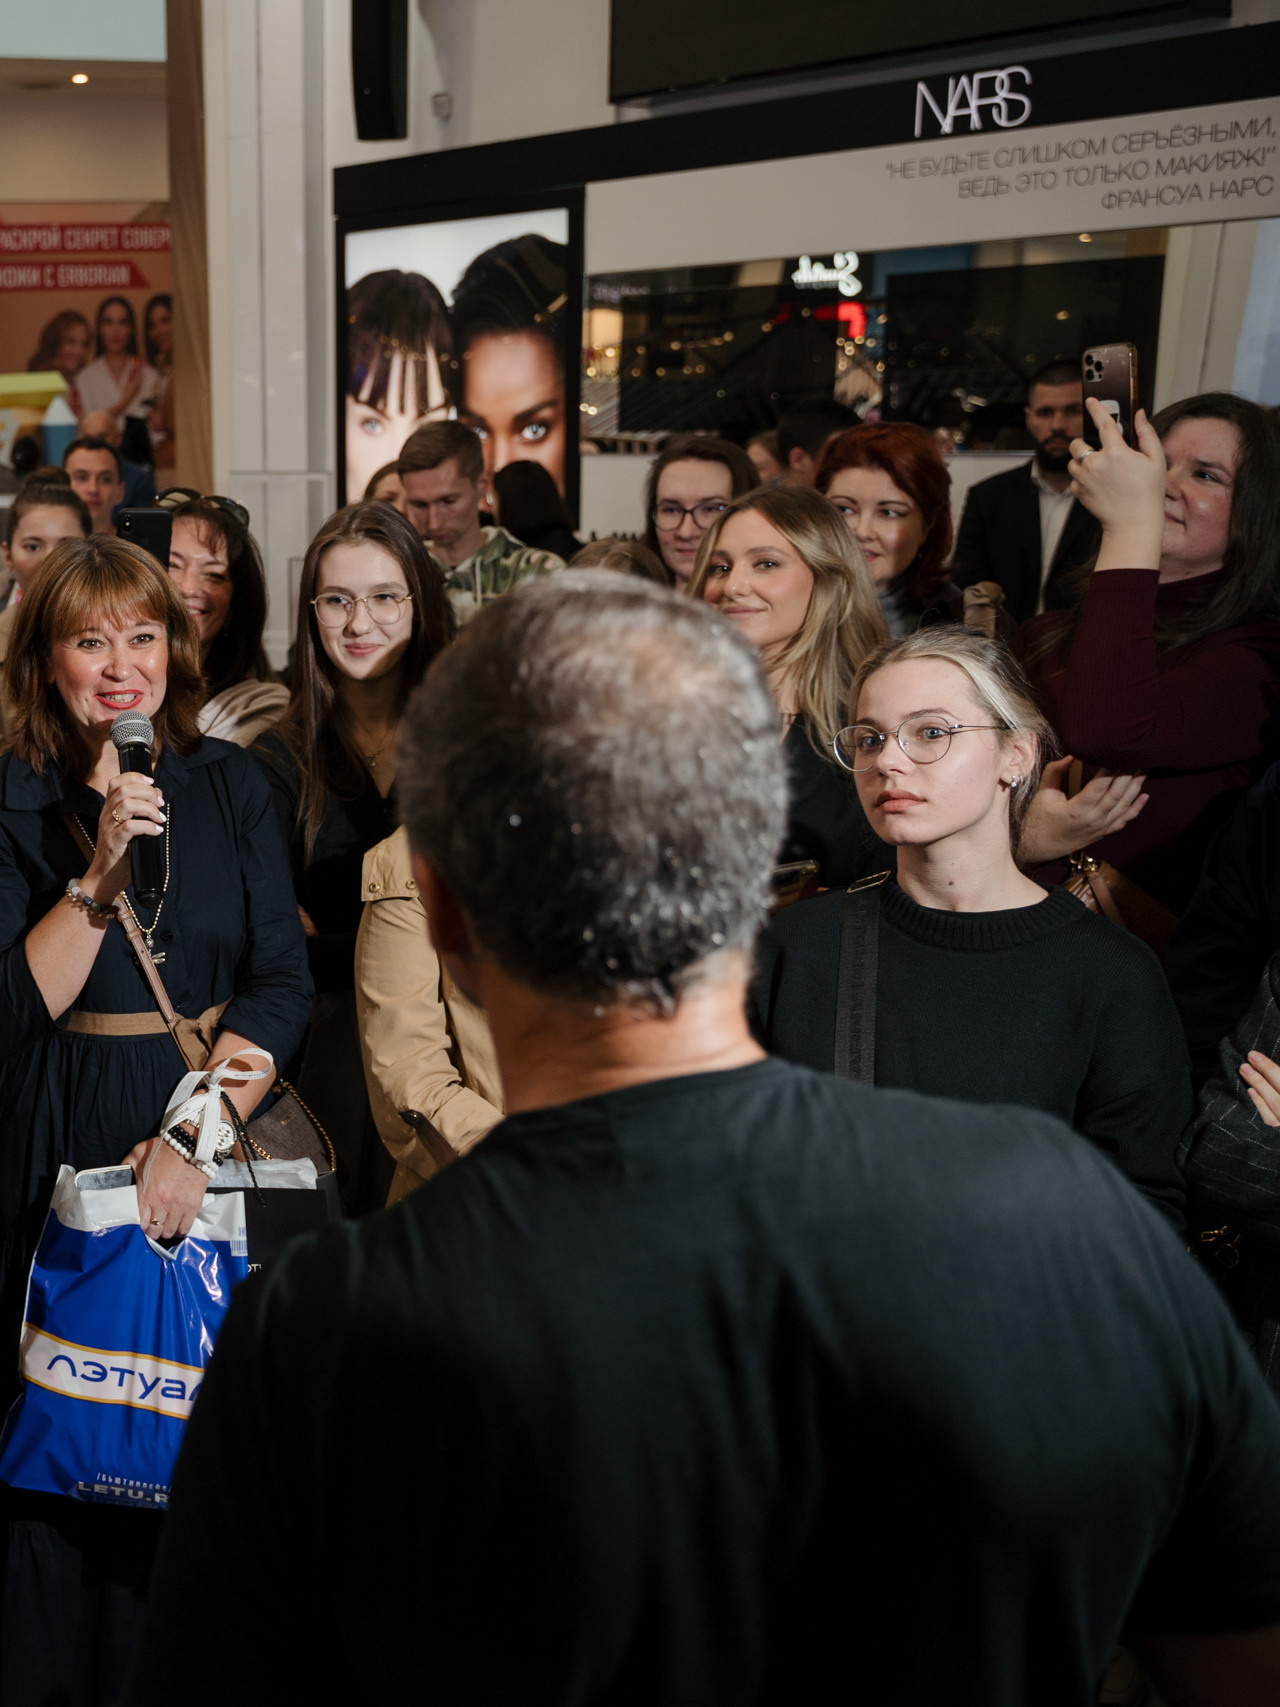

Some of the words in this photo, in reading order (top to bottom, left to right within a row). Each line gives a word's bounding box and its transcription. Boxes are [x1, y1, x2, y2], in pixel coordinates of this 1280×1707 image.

[914, 65, 1033, 138] NARS
[919, 151, 992, 178] БУДЬТЕ
[994, 136, 1107, 168] СЛИШКОМ
[1111, 116, 1277, 155] СЕРЬЁЗНЫМИ,
[958, 175, 1011, 199] ВЕДЬ
[1015, 169, 1058, 193] ЭТО
[1063, 160, 1150, 187] ТОЛЬКО
[1101, 183, 1203, 210] ФРАНСУА
[1209, 175, 1275, 201] НАРС
[64, 227, 118, 250] СЕКРЕТ
[121, 226, 171, 249] СОВЕР
[56, 263, 131, 288] ERBORIAN
[78, 1481, 169, 1503] LETU.R
